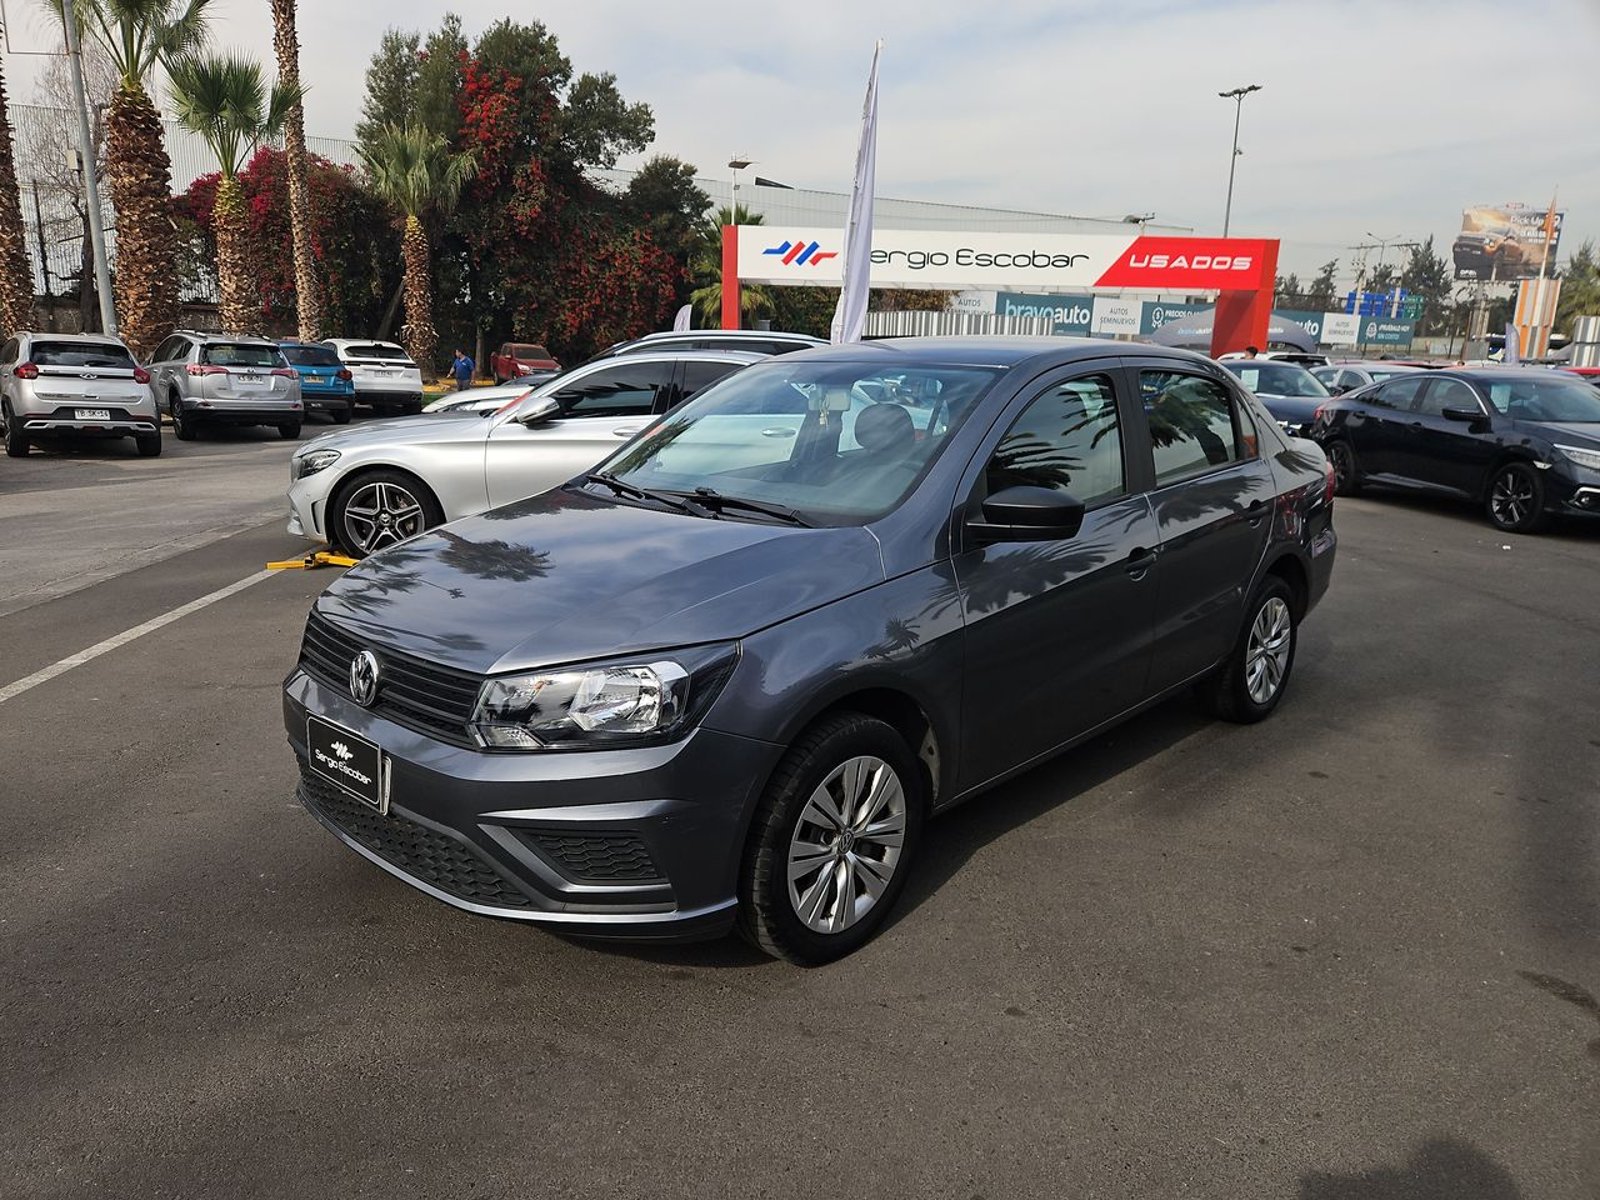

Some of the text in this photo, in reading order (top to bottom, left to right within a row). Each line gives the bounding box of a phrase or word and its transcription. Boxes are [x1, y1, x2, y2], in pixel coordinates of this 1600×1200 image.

[869, 248, 1090, 270] ergio Escobar
[1129, 254, 1253, 270] USADOS
[958, 298, 981, 307] AUTOS
[1005, 299, 1091, 325] bravoauto
[1109, 307, 1129, 316] AUTOS
[338, 760, 372, 785] Escobar
